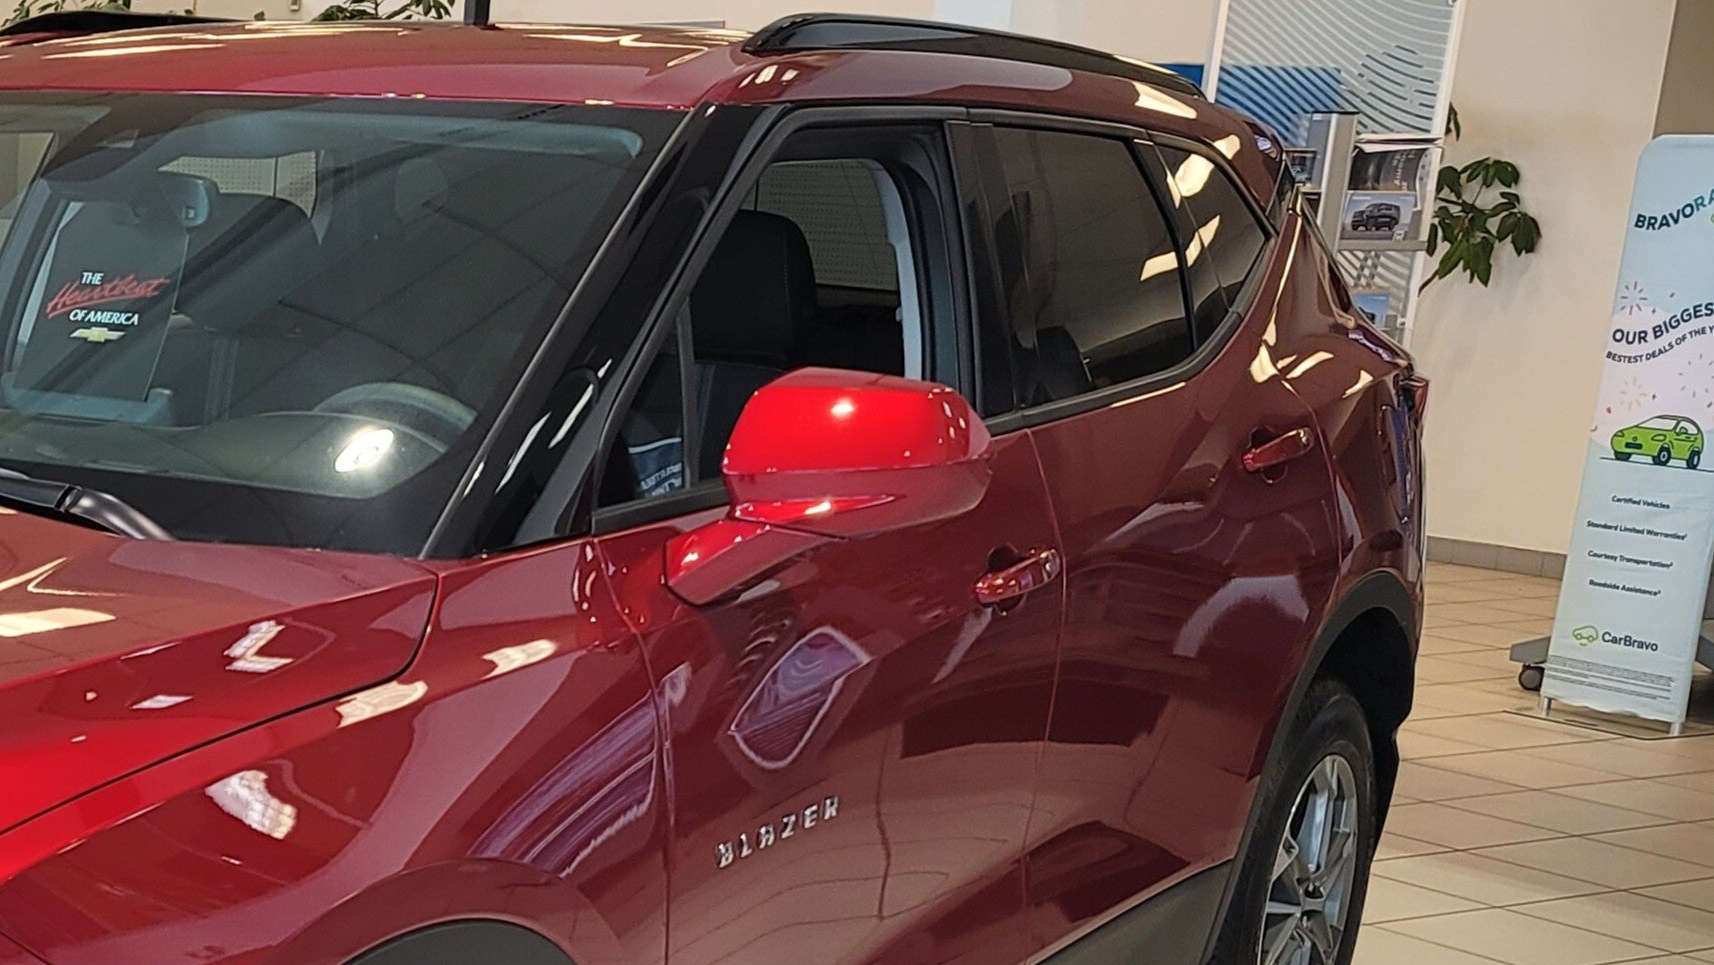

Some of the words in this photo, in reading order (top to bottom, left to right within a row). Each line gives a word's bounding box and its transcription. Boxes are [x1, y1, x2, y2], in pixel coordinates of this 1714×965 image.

[81, 271, 104, 285] THE
[69, 309, 87, 322] OF
[84, 311, 139, 326] AMERICA
[1611, 328, 1648, 345] OUR
[1652, 302, 1714, 340] BIGGES
[1606, 351, 1644, 364] BESTEST
[1645, 341, 1674, 361] DEALS
[1675, 333, 1688, 346] OF
[1688, 326, 1707, 339] THE
[1611, 495, 1641, 506] Certified
[1642, 499, 1670, 509] Vehicles
[1587, 520, 1618, 531] Standard
[1619, 524, 1645, 535] Limited
[1588, 550, 1618, 562] Courtesy
[1601, 631, 1659, 652] CarBravo
[717, 796, 839, 868] BLAZER
